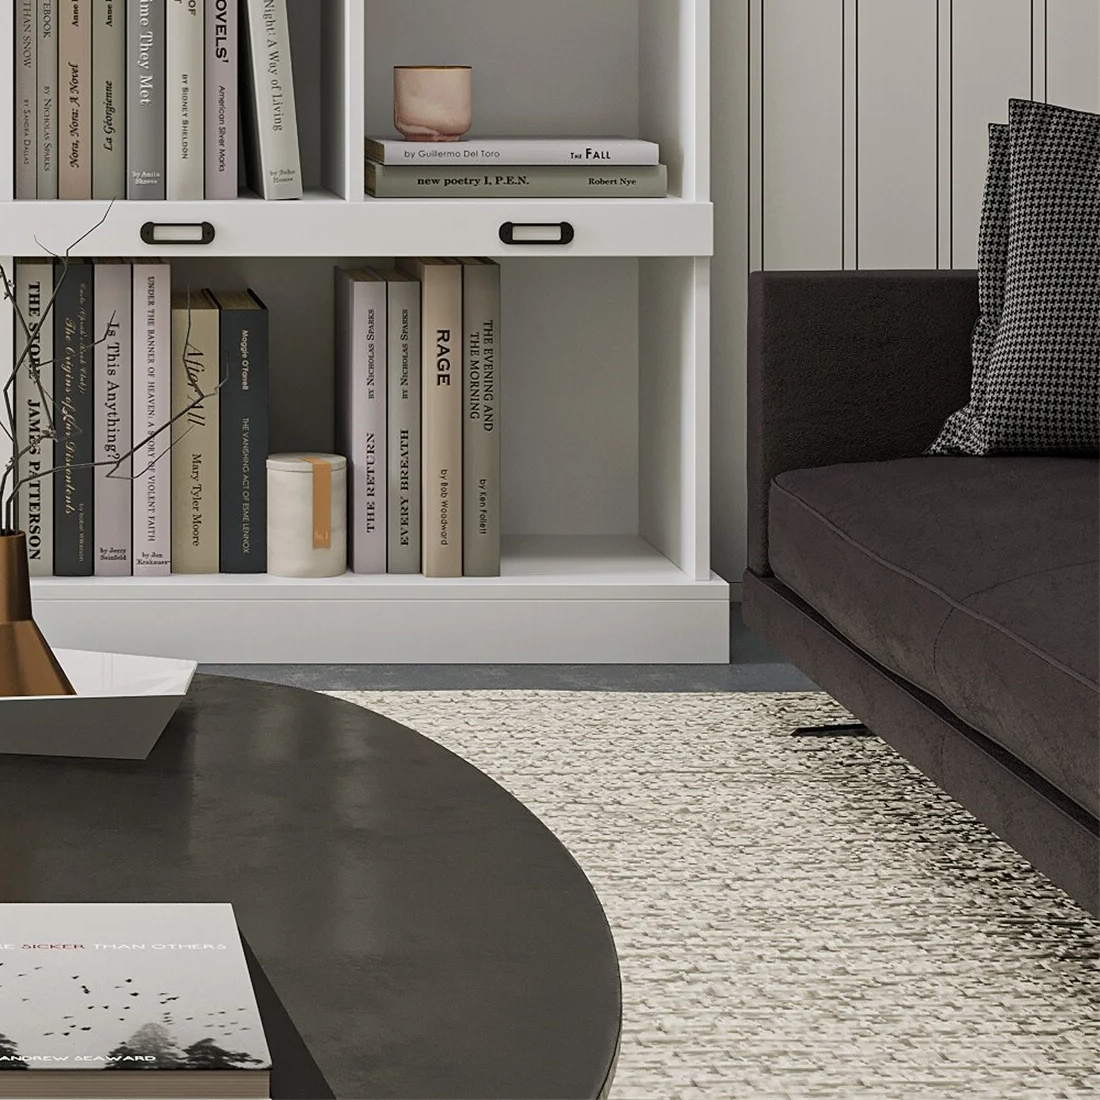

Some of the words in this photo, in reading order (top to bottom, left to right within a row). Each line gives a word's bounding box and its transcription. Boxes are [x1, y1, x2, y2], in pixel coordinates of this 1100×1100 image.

[404, 150, 415, 159] by
[418, 150, 461, 158] Guillermo
[464, 150, 478, 158] Del
[444, 178, 480, 186] poetry
[620, 178, 636, 186] Nye
[106, 323, 120, 336] Is
[106, 343, 120, 376] This
[437, 330, 450, 386] RAGE
[28, 399, 41, 454] JAMES
[105, 380, 120, 460] Anything?
[190, 454, 202, 481] Mary
[28, 461, 41, 559] PATTERSON
[191, 484, 202, 511] Tyler
[193, 514, 202, 546] Moore
